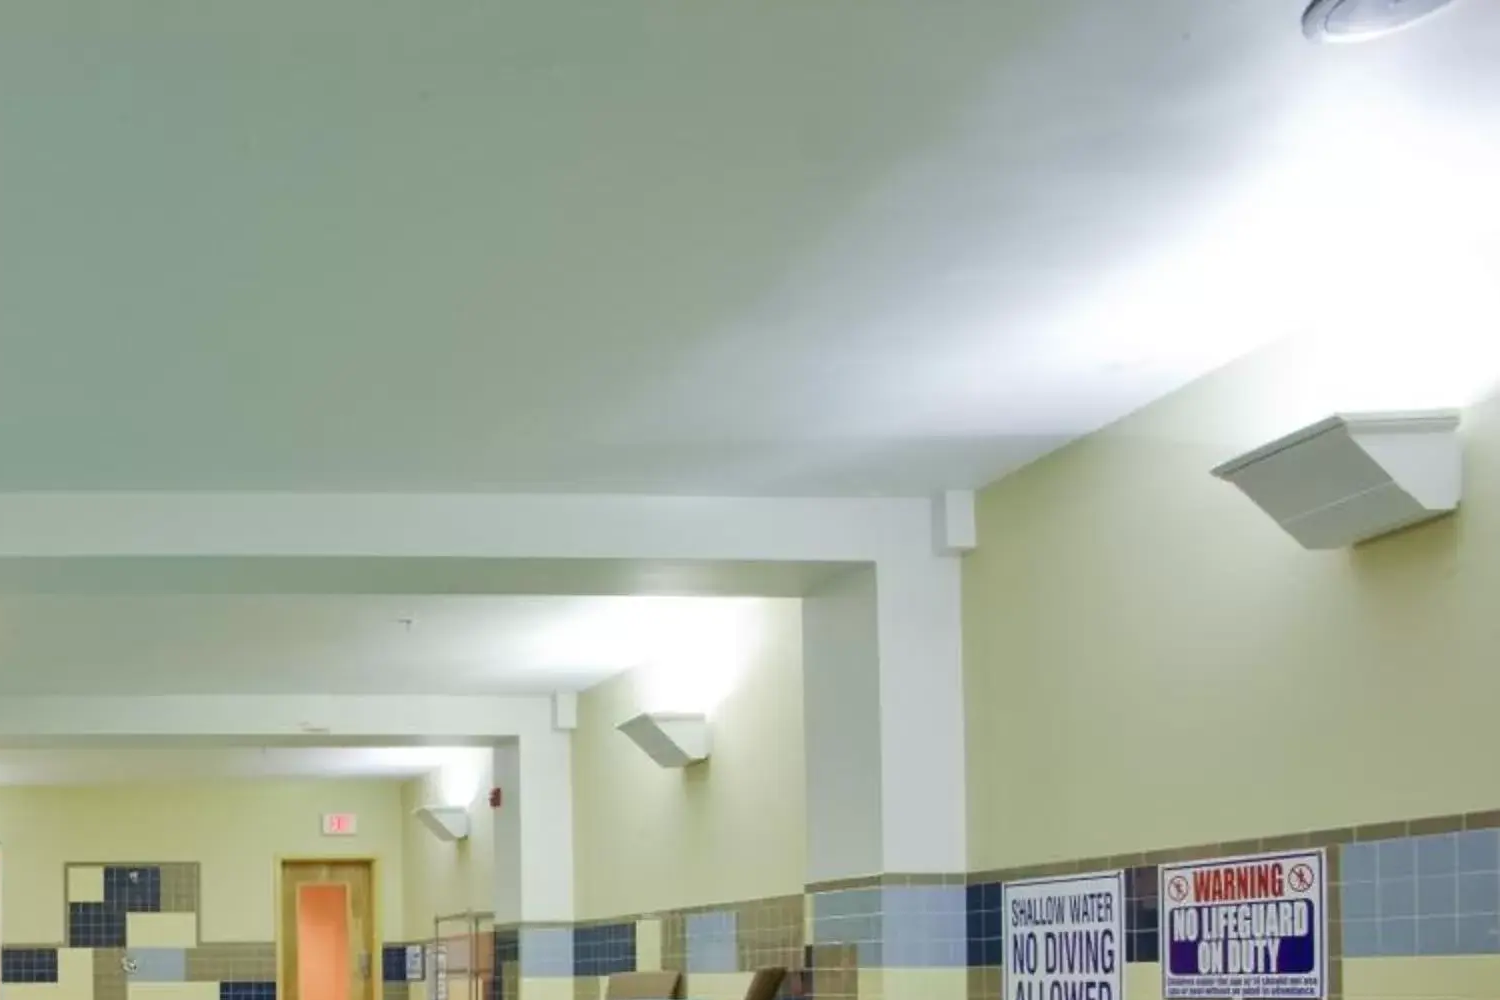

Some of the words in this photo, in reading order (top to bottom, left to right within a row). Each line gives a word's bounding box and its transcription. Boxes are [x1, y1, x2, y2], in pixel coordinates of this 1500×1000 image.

[1193, 862, 1285, 904] WARNING
[1012, 895, 1065, 927] SHALLOW
[1068, 892, 1113, 924] WATER
[1172, 906, 1199, 942] NO
[1201, 900, 1309, 940] LIFEGUARD
[1013, 931, 1037, 975] NO
[1044, 928, 1114, 975] DIVING
[1197, 940, 1224, 974] ON
[1227, 938, 1281, 974] DUTY
